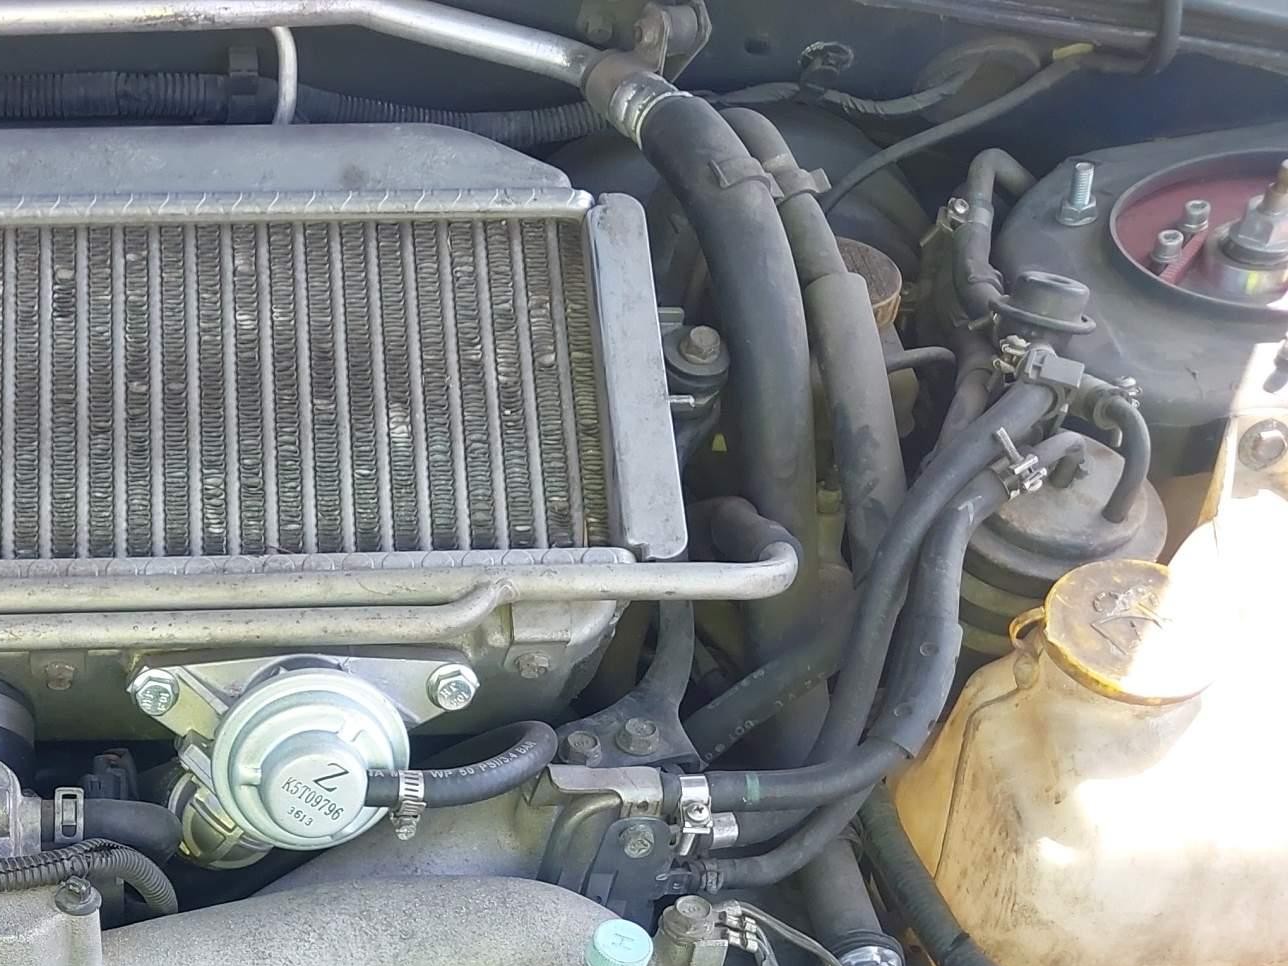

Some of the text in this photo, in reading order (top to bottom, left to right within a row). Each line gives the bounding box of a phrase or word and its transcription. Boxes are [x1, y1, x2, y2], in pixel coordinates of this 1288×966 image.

[312, 762, 350, 793] Z
[280, 776, 346, 822] K5T09796
[286, 805, 314, 827] 3613
